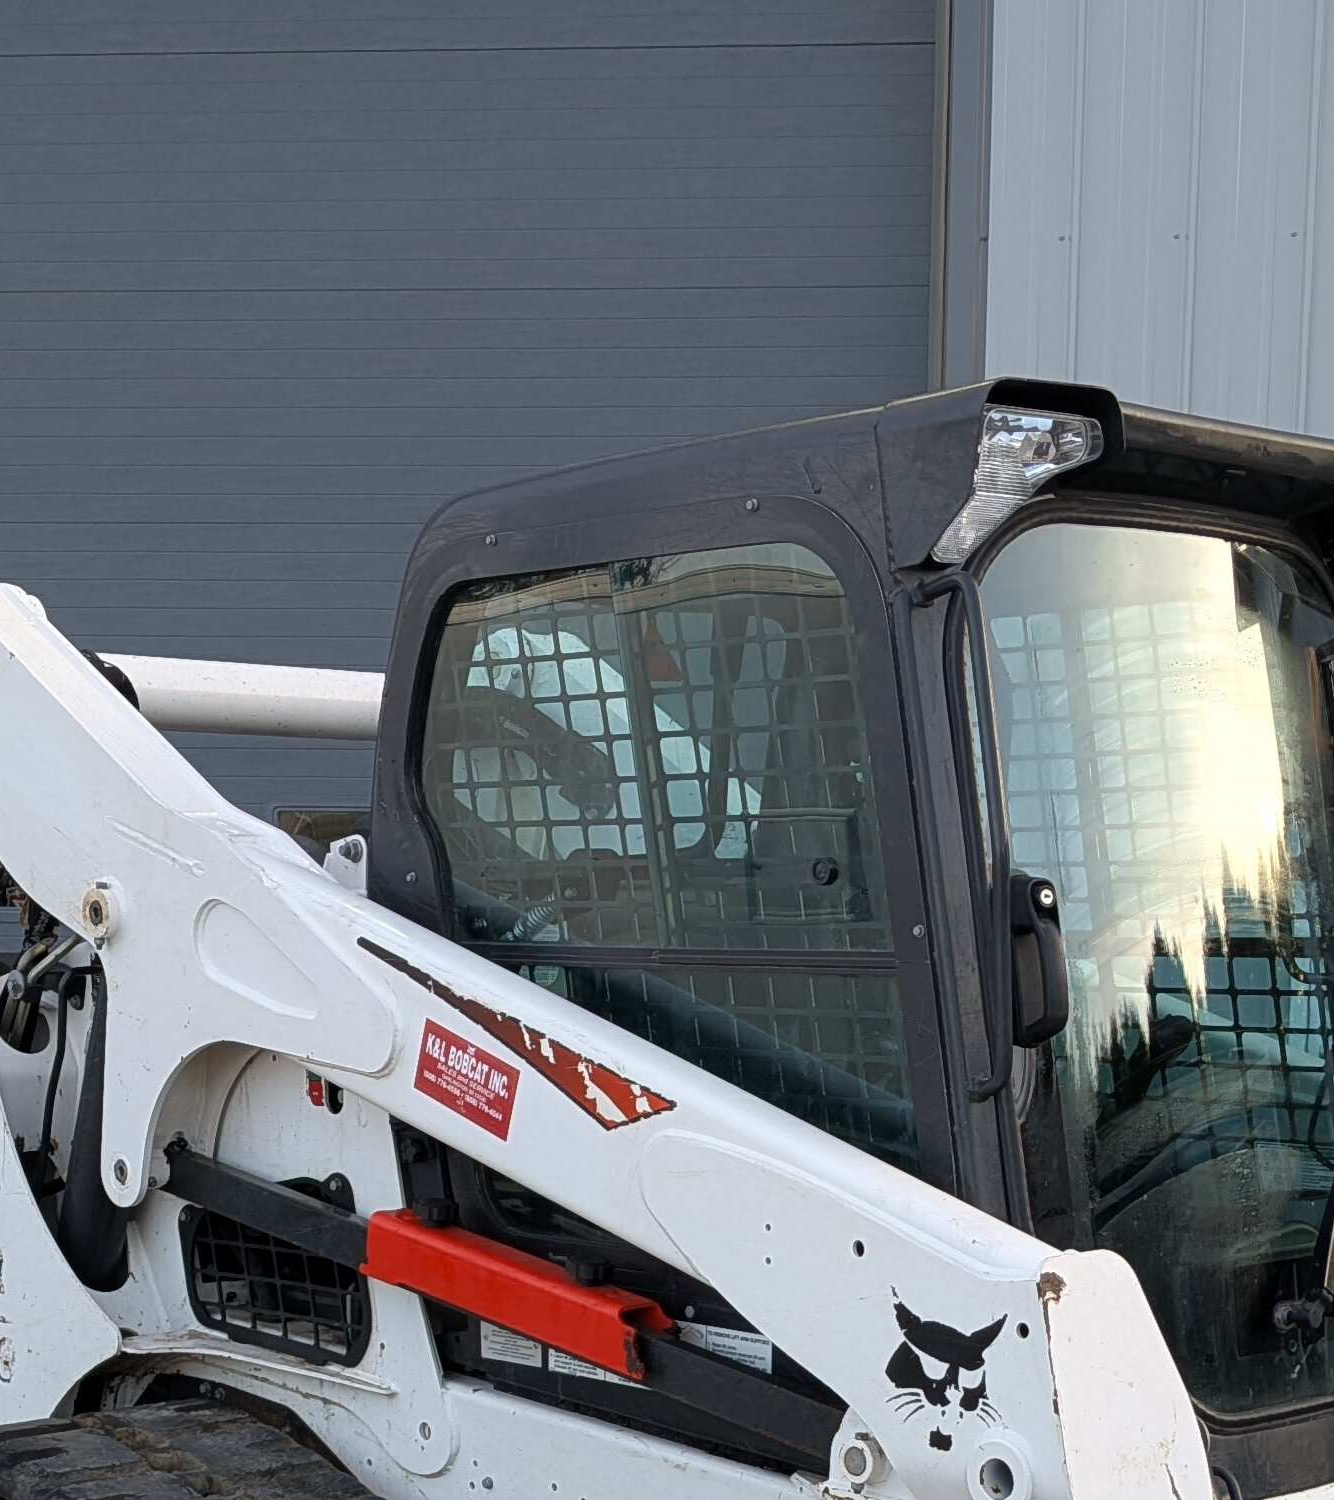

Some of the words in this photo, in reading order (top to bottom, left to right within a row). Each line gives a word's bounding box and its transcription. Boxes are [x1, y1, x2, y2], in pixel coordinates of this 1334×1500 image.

[425, 1032, 446, 1063] K&L
[447, 1045, 489, 1086] BOBCAT
[487, 1068, 509, 1099] INC.
[436, 1062, 457, 1078] SALES
[468, 1080, 495, 1100] SERVICE
